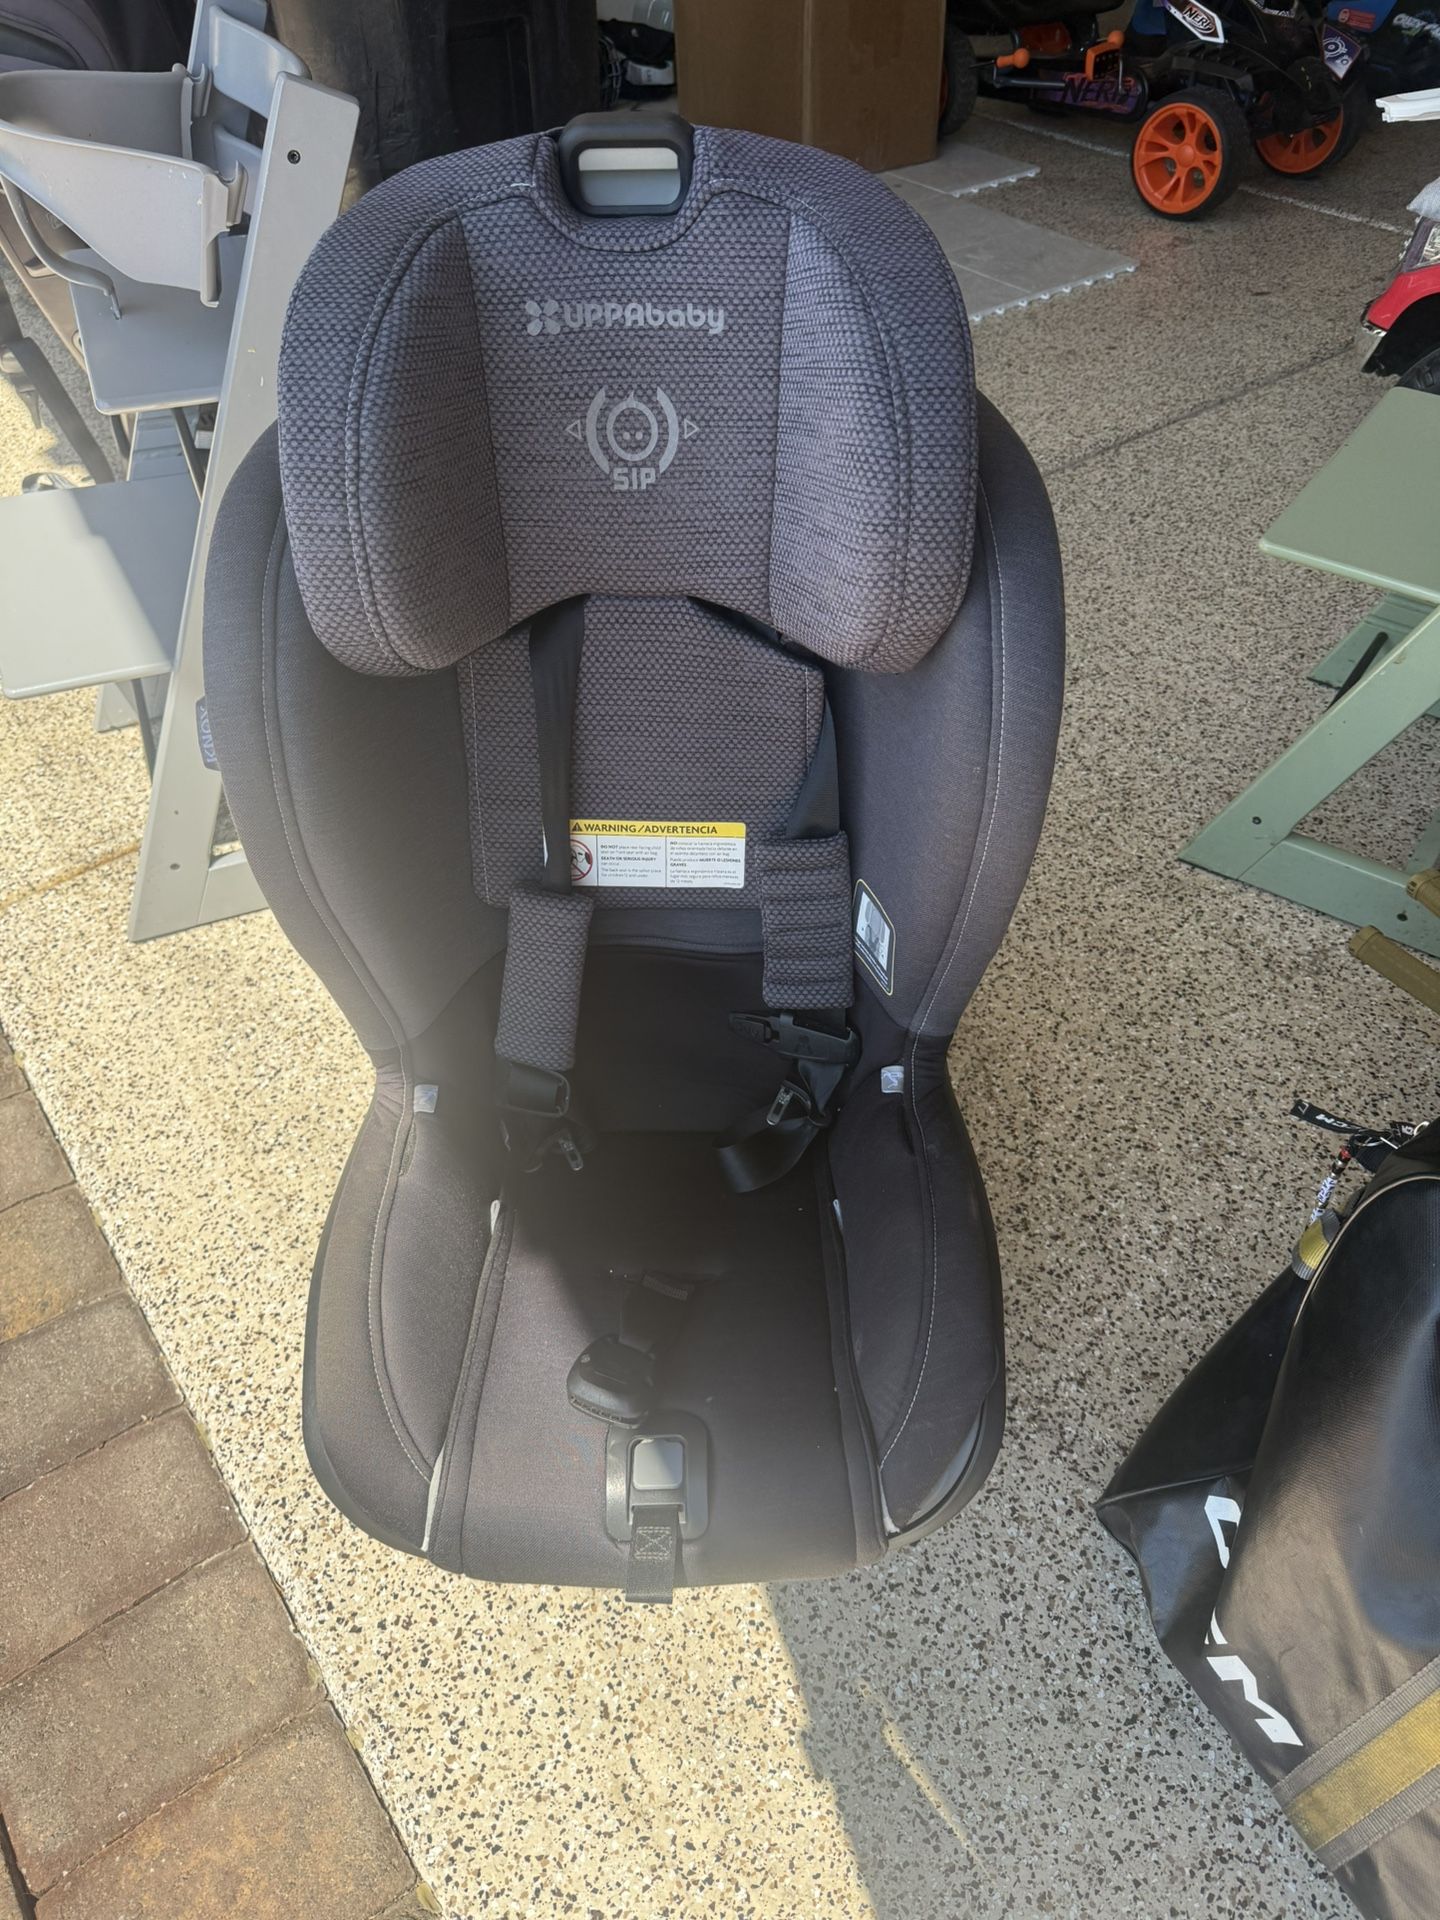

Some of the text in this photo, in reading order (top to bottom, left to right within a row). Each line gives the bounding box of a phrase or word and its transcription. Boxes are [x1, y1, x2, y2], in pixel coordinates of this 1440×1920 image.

[1182, 6, 1215, 29] NERF
[564, 302, 725, 335] UPPAbaby
[612, 466, 657, 490] SIP
